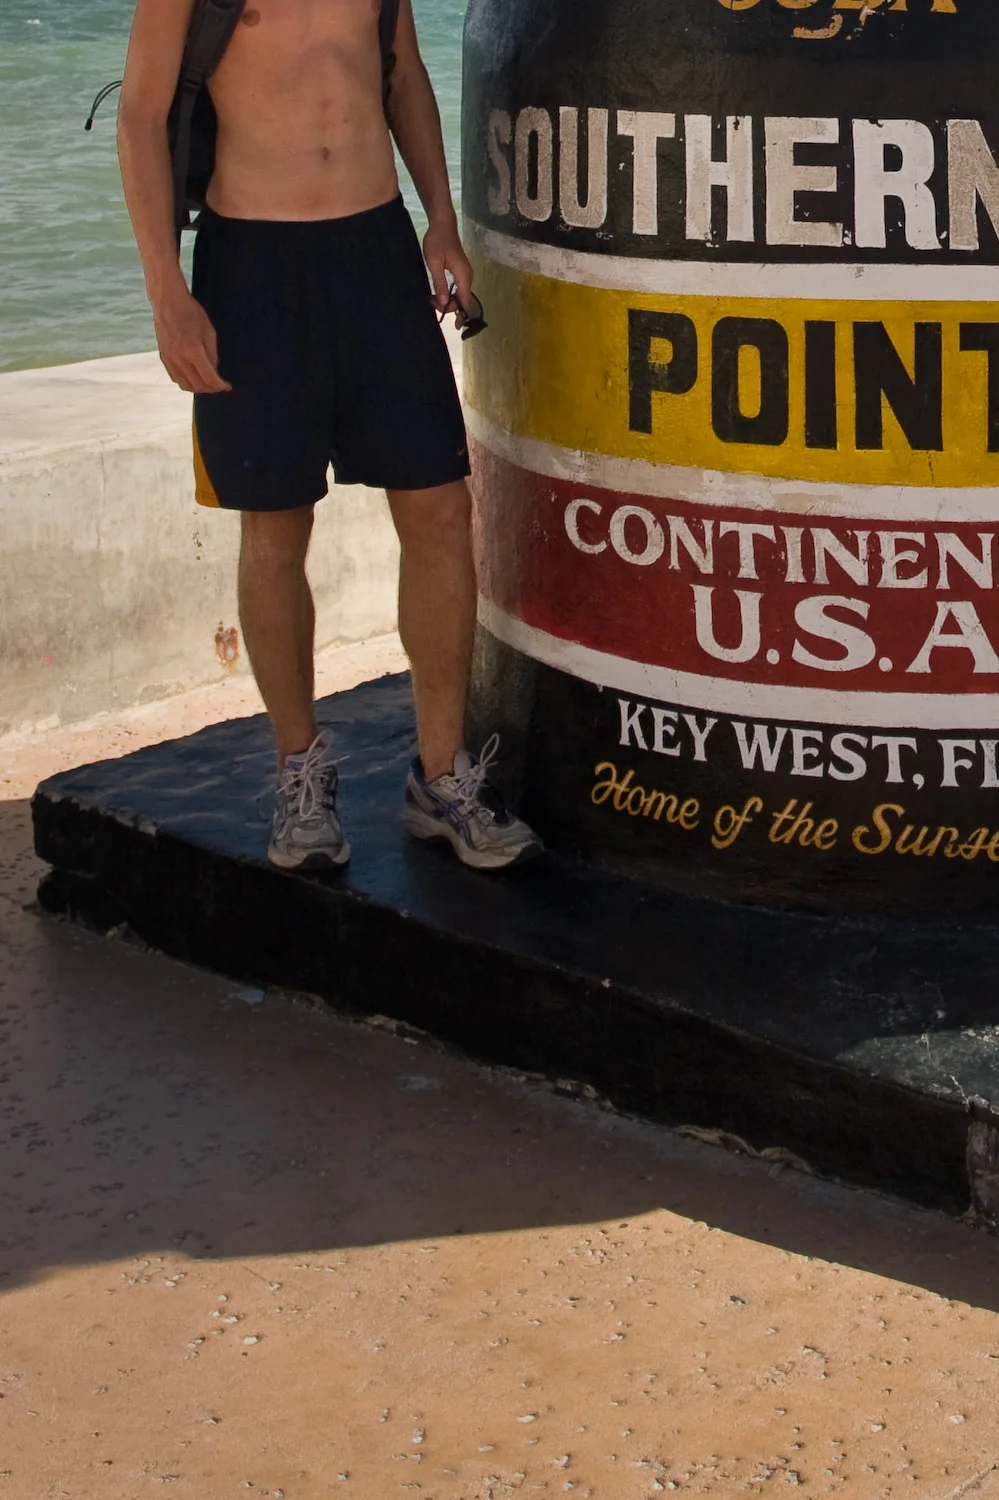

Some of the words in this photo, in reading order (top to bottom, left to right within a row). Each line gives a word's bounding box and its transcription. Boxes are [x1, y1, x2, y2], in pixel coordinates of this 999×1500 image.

[617, 699, 718, 762] KEY
[731, 722, 925, 790] WEST,
[590, 761, 700, 829] Home
[711, 797, 762, 849] of
[768, 798, 838, 851] the
